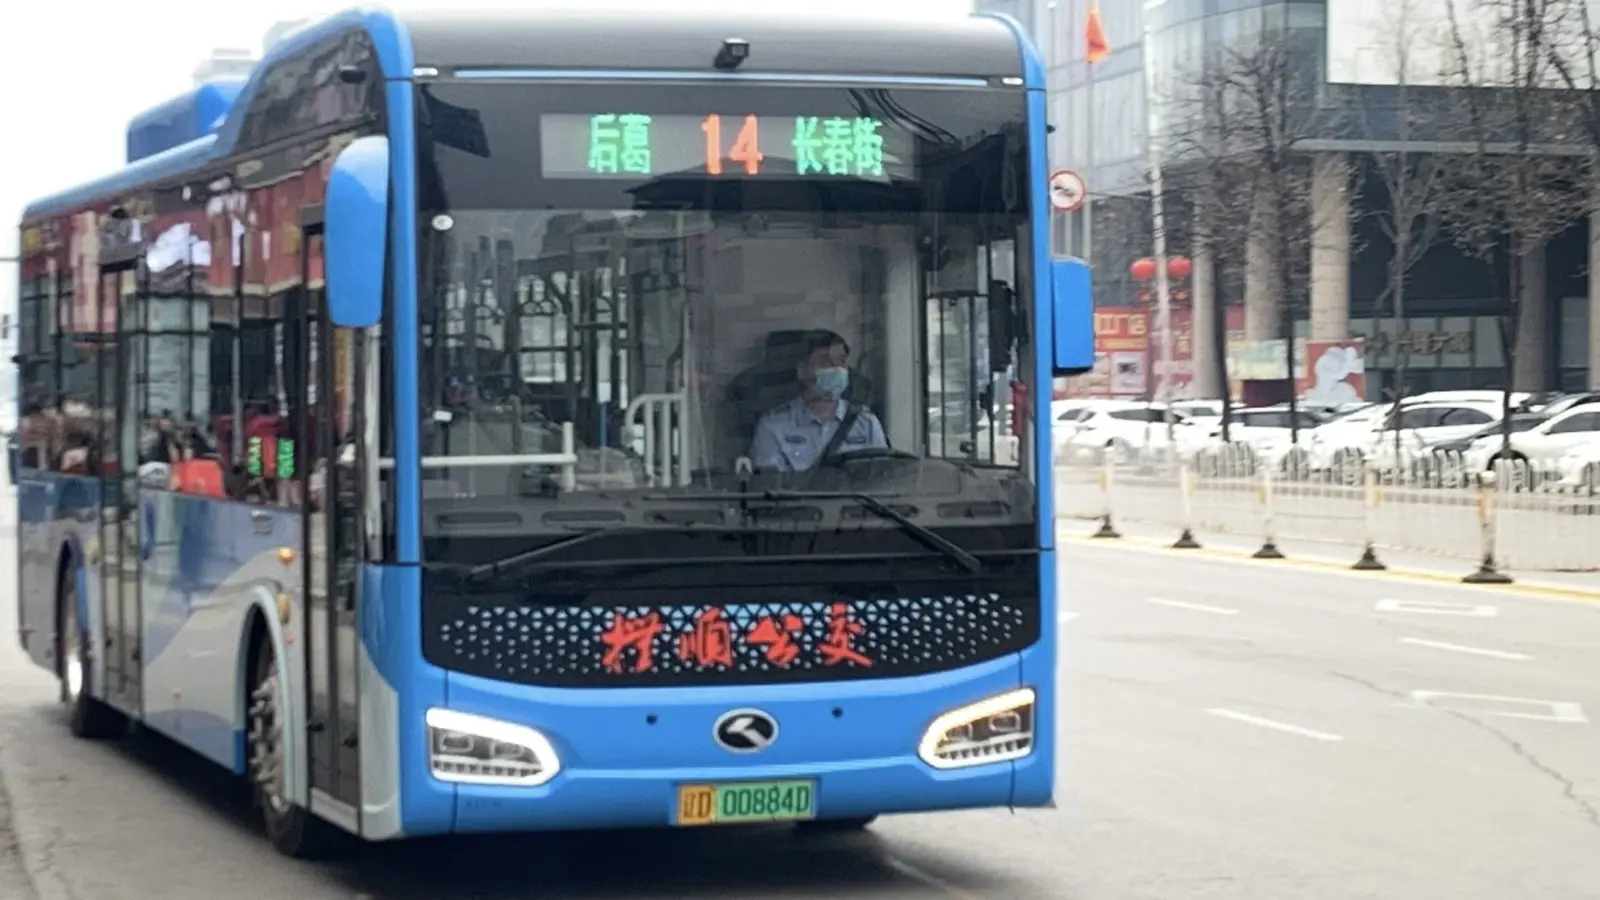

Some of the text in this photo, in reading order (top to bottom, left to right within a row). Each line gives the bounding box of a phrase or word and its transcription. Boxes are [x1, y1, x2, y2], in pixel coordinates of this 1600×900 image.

[587, 113, 883, 176] 后葛 14 长春街
[601, 602, 872, 673] 抚顺公交
